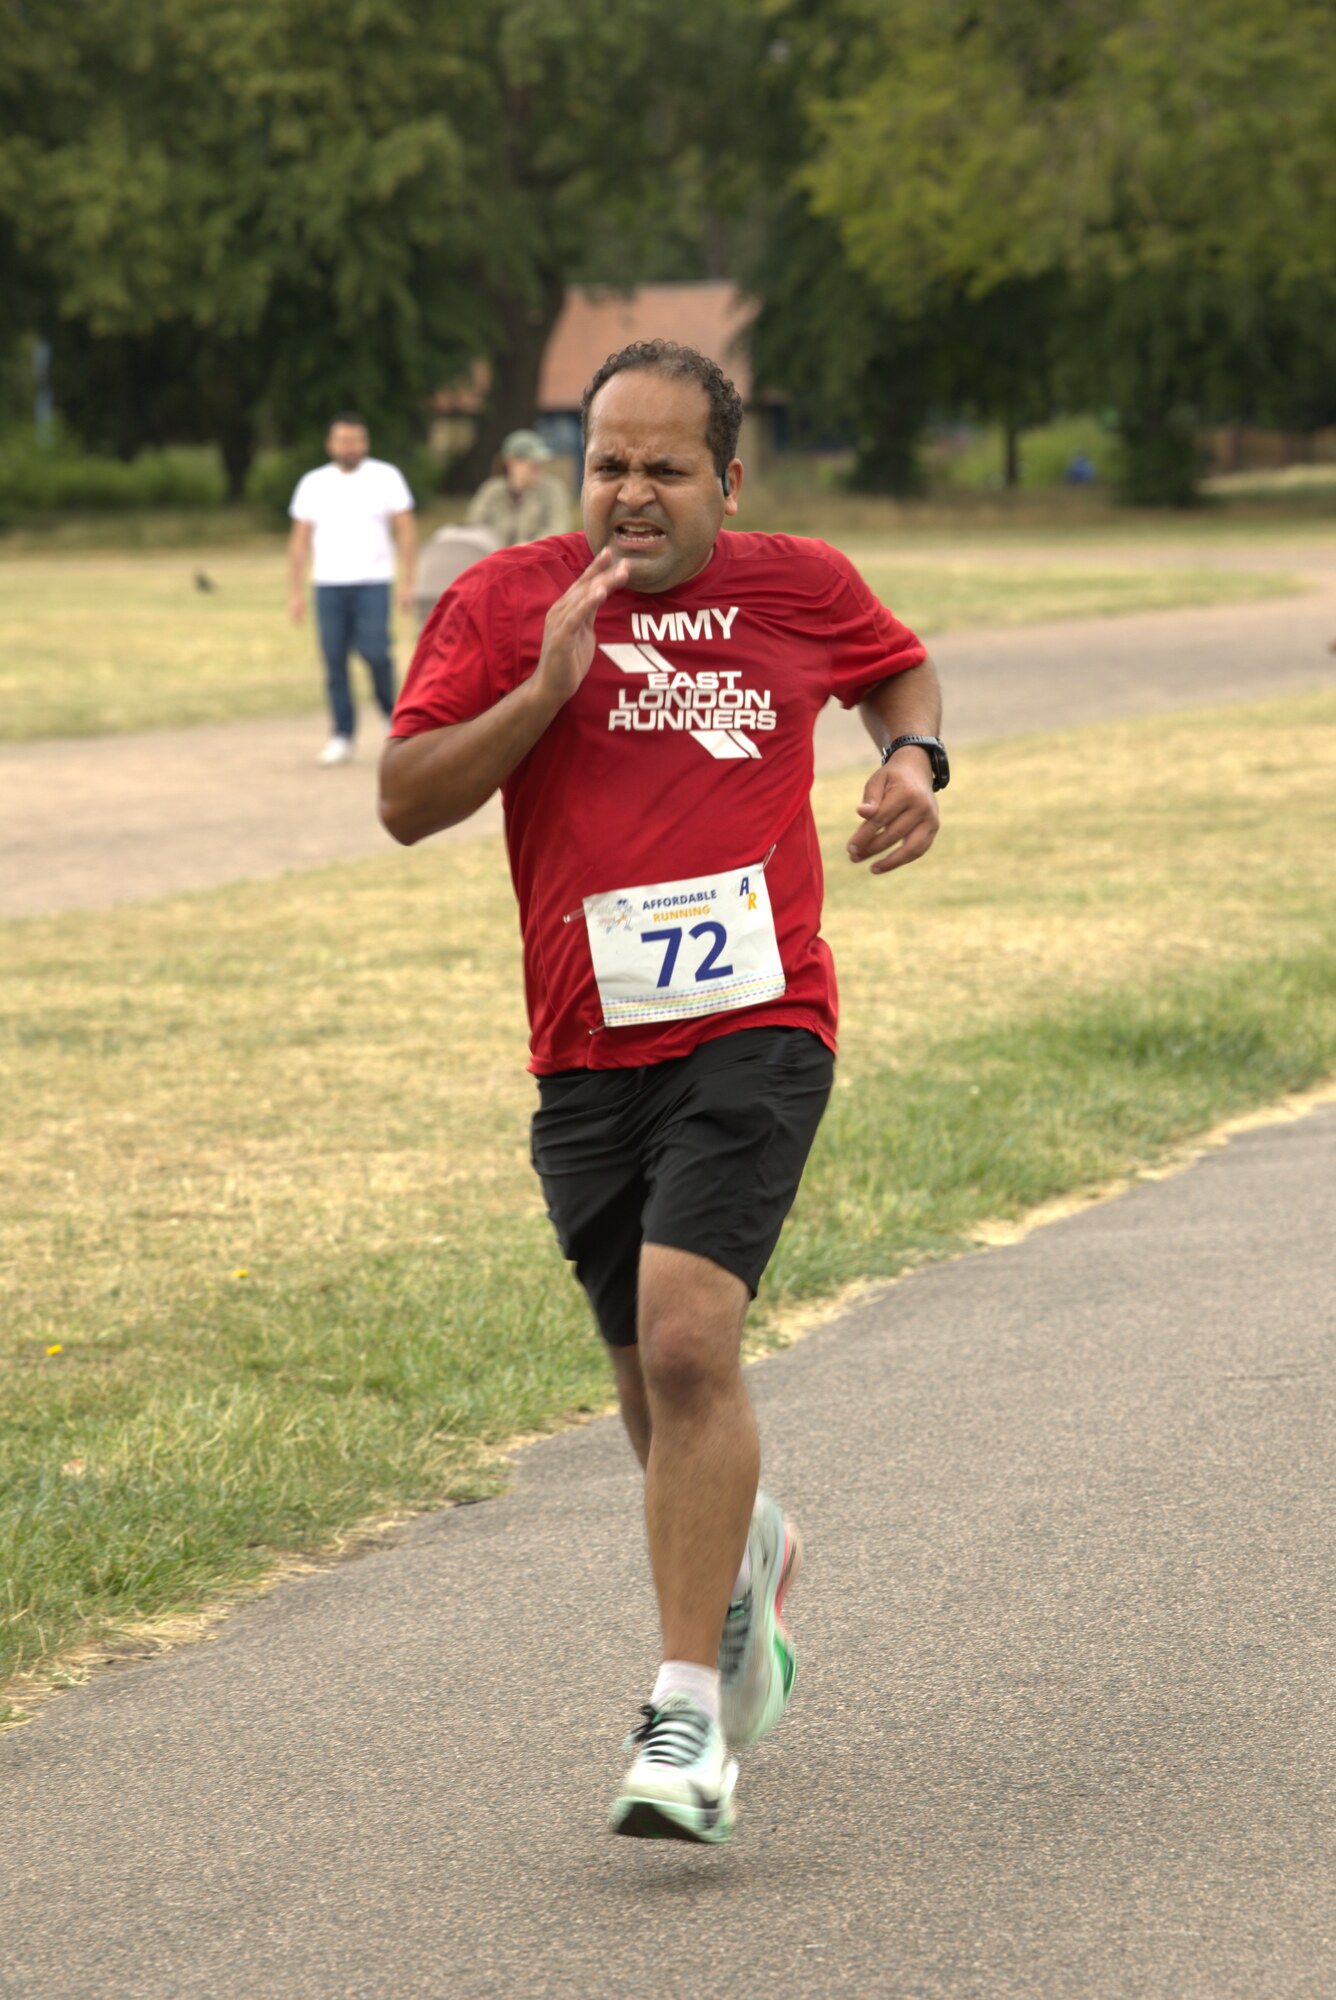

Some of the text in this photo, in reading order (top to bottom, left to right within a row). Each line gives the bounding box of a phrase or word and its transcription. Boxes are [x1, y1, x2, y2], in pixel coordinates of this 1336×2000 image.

[631, 606, 740, 641] IMMY
[647, 671, 742, 690] EAST
[618, 688, 771, 710] LONDON
[608, 709, 777, 731] RUNNERS
[642, 889, 717, 911] AFFORDABLE
[653, 904, 711, 923] RUNNING
[640, 920, 734, 989] 72
